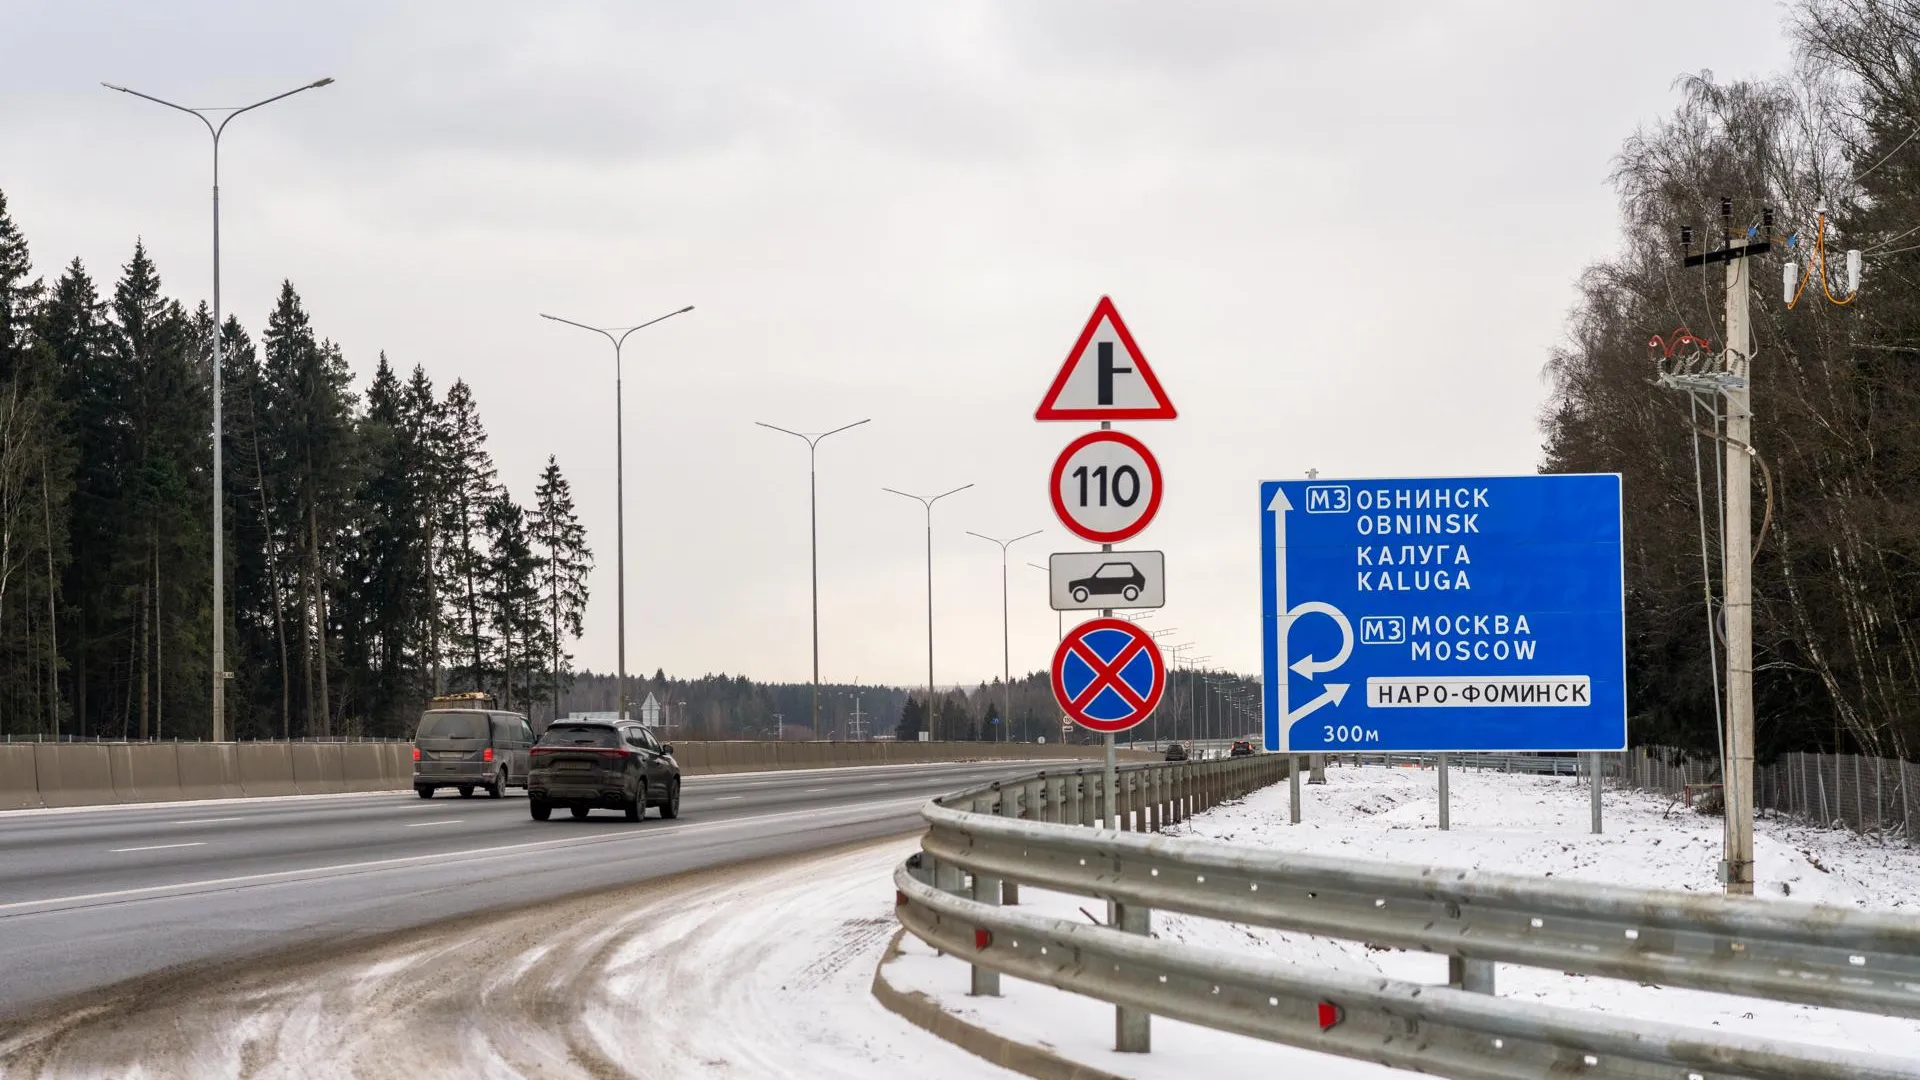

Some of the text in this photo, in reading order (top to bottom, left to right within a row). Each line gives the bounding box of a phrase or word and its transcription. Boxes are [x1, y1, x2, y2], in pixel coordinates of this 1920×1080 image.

[1072, 465, 1141, 507] 110
[1310, 487, 1489, 510] М3 ОБНИНСК
[1357, 513, 1479, 535] OBNINSK
[1357, 544, 1471, 566] КАЛУГА
[1357, 570, 1471, 591] KALUGA
[1365, 614, 1531, 641] М3 МОСКВА
[1411, 640, 1537, 661] MOSCOW
[1379, 683, 1587, 704] НАРО-ФОМИНСК
[1323, 725, 1379, 743] 300м
